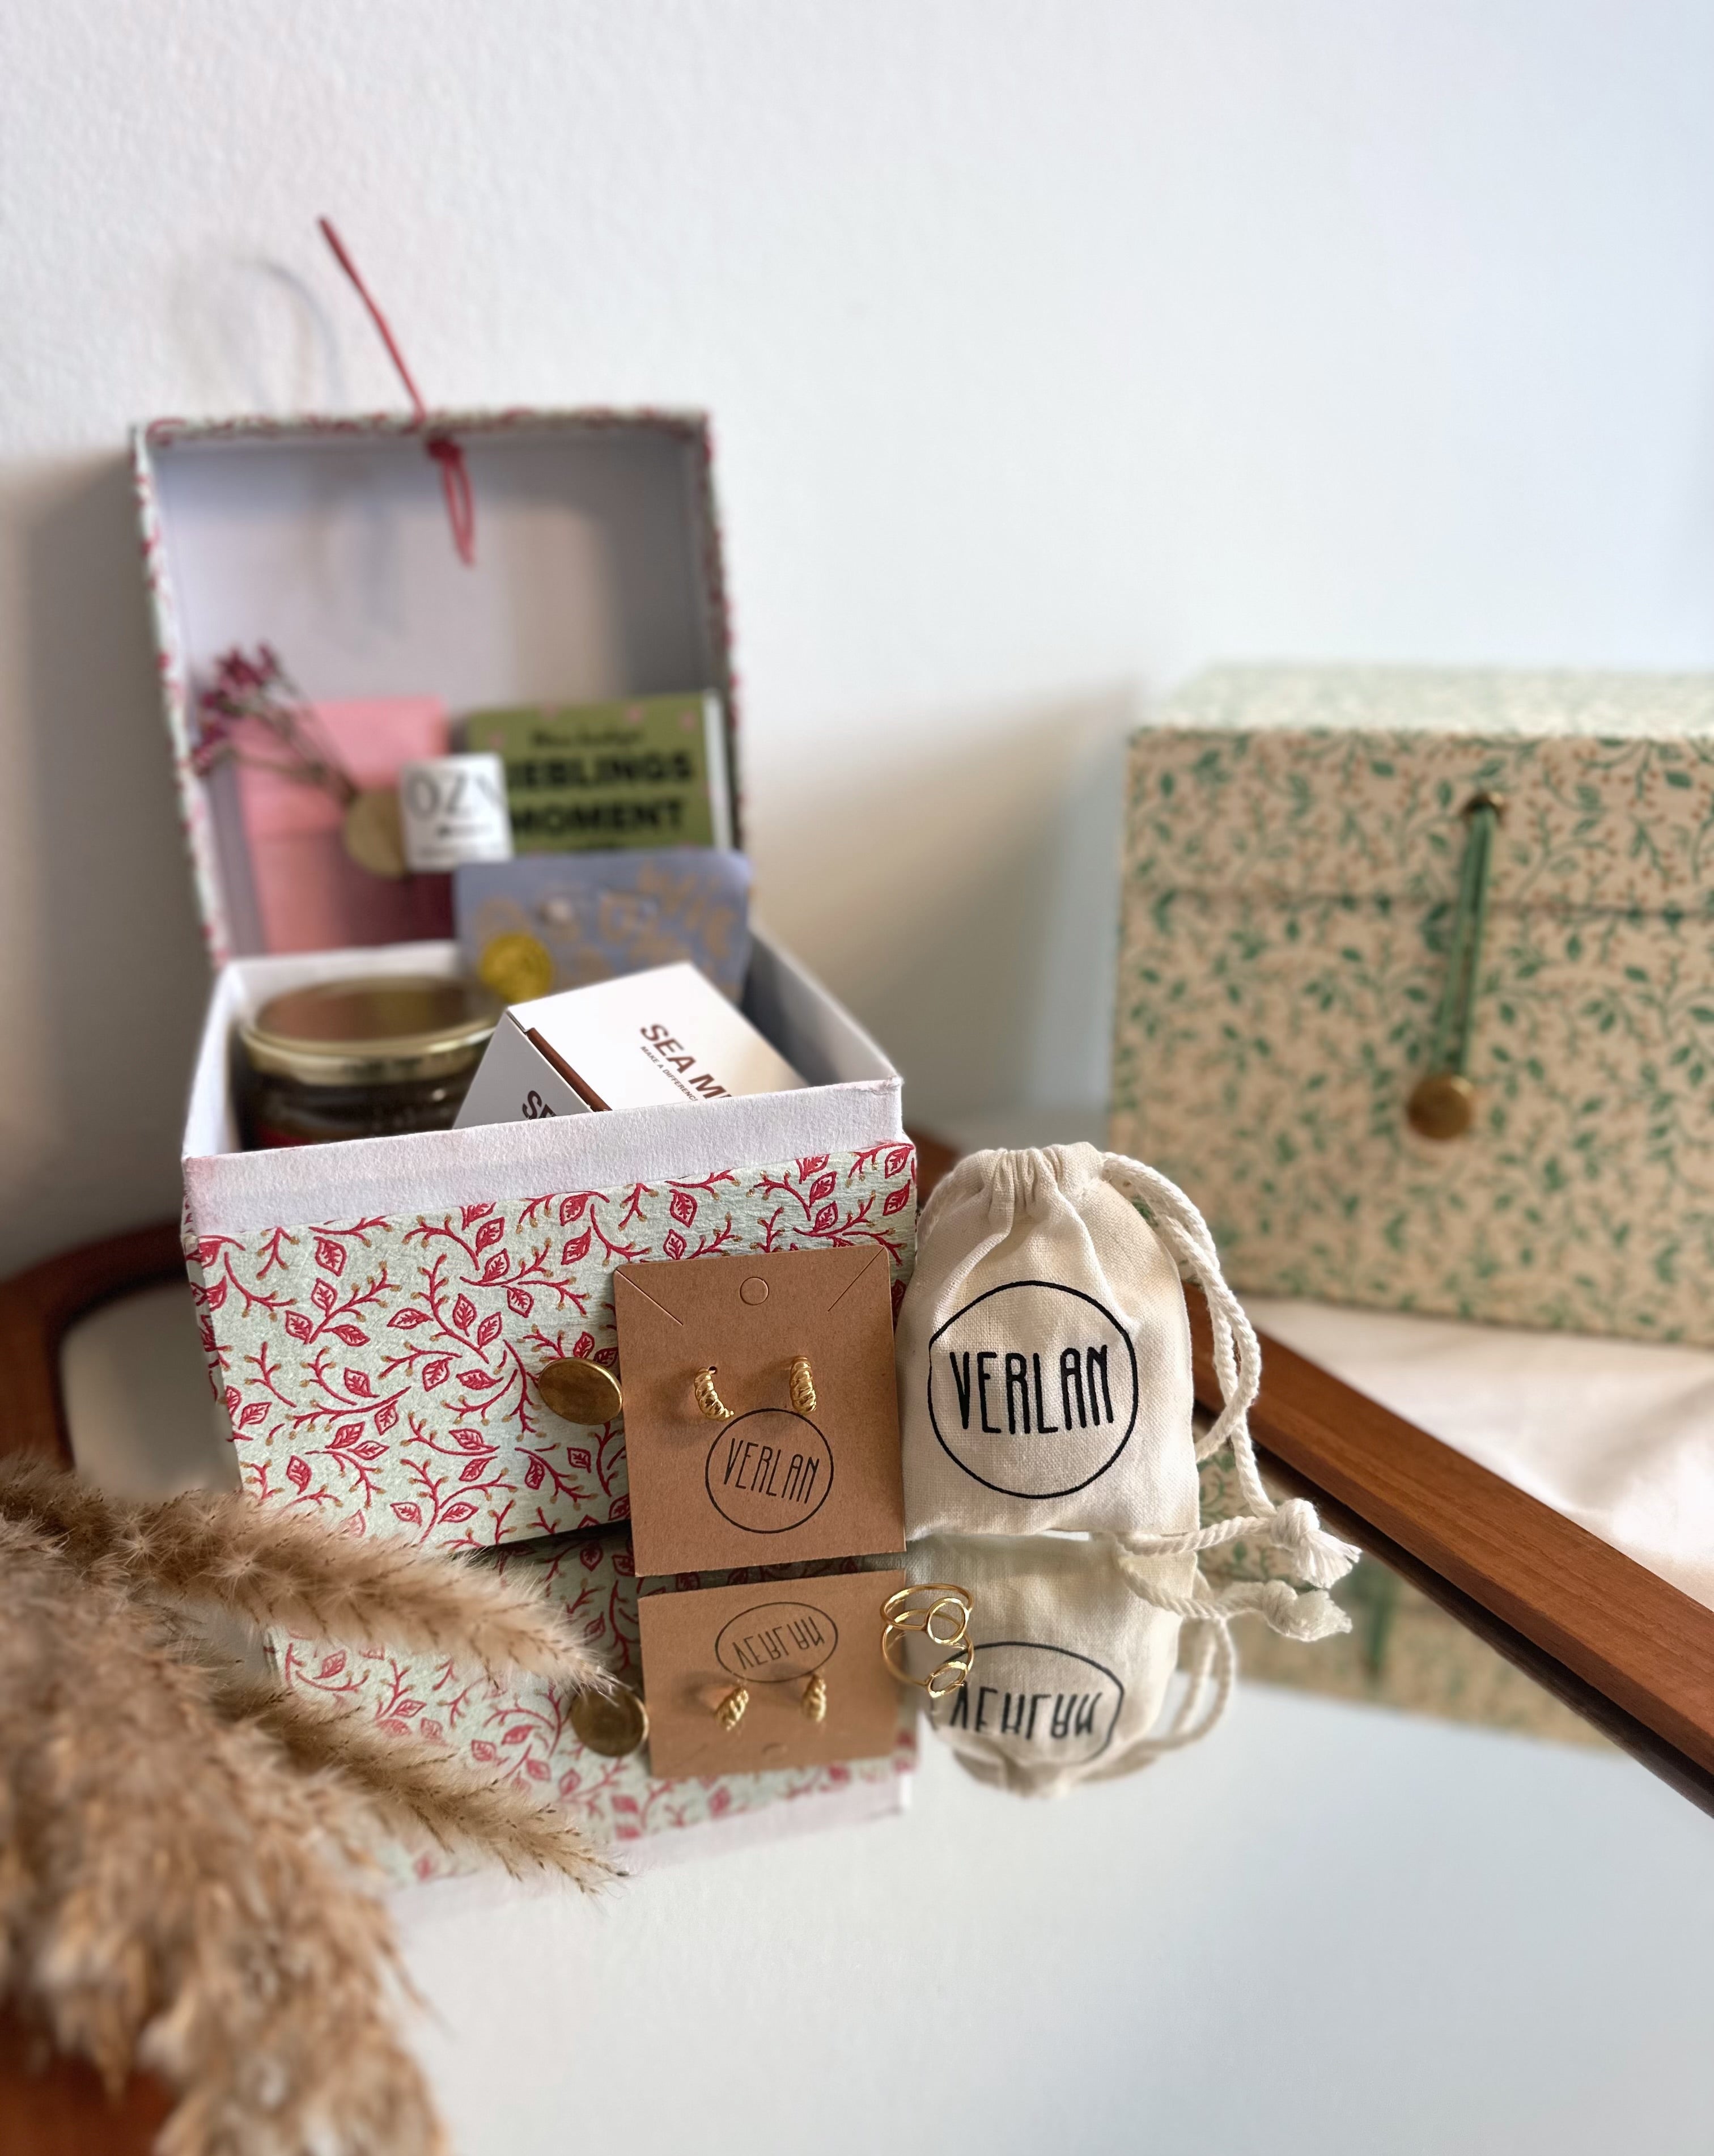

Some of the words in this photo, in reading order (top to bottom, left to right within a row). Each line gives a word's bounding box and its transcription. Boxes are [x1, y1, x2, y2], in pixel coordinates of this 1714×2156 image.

[508, 748, 692, 790] IEBLINGS
[510, 795, 684, 838] MOMENT
[640, 1045, 659, 1064] MAKE
[640, 1023, 697, 1074] SEA
[688, 1073, 733, 1099] M
[949, 1344, 1114, 1435] VERLAN
[723, 1437, 820, 1504] VERLAN
